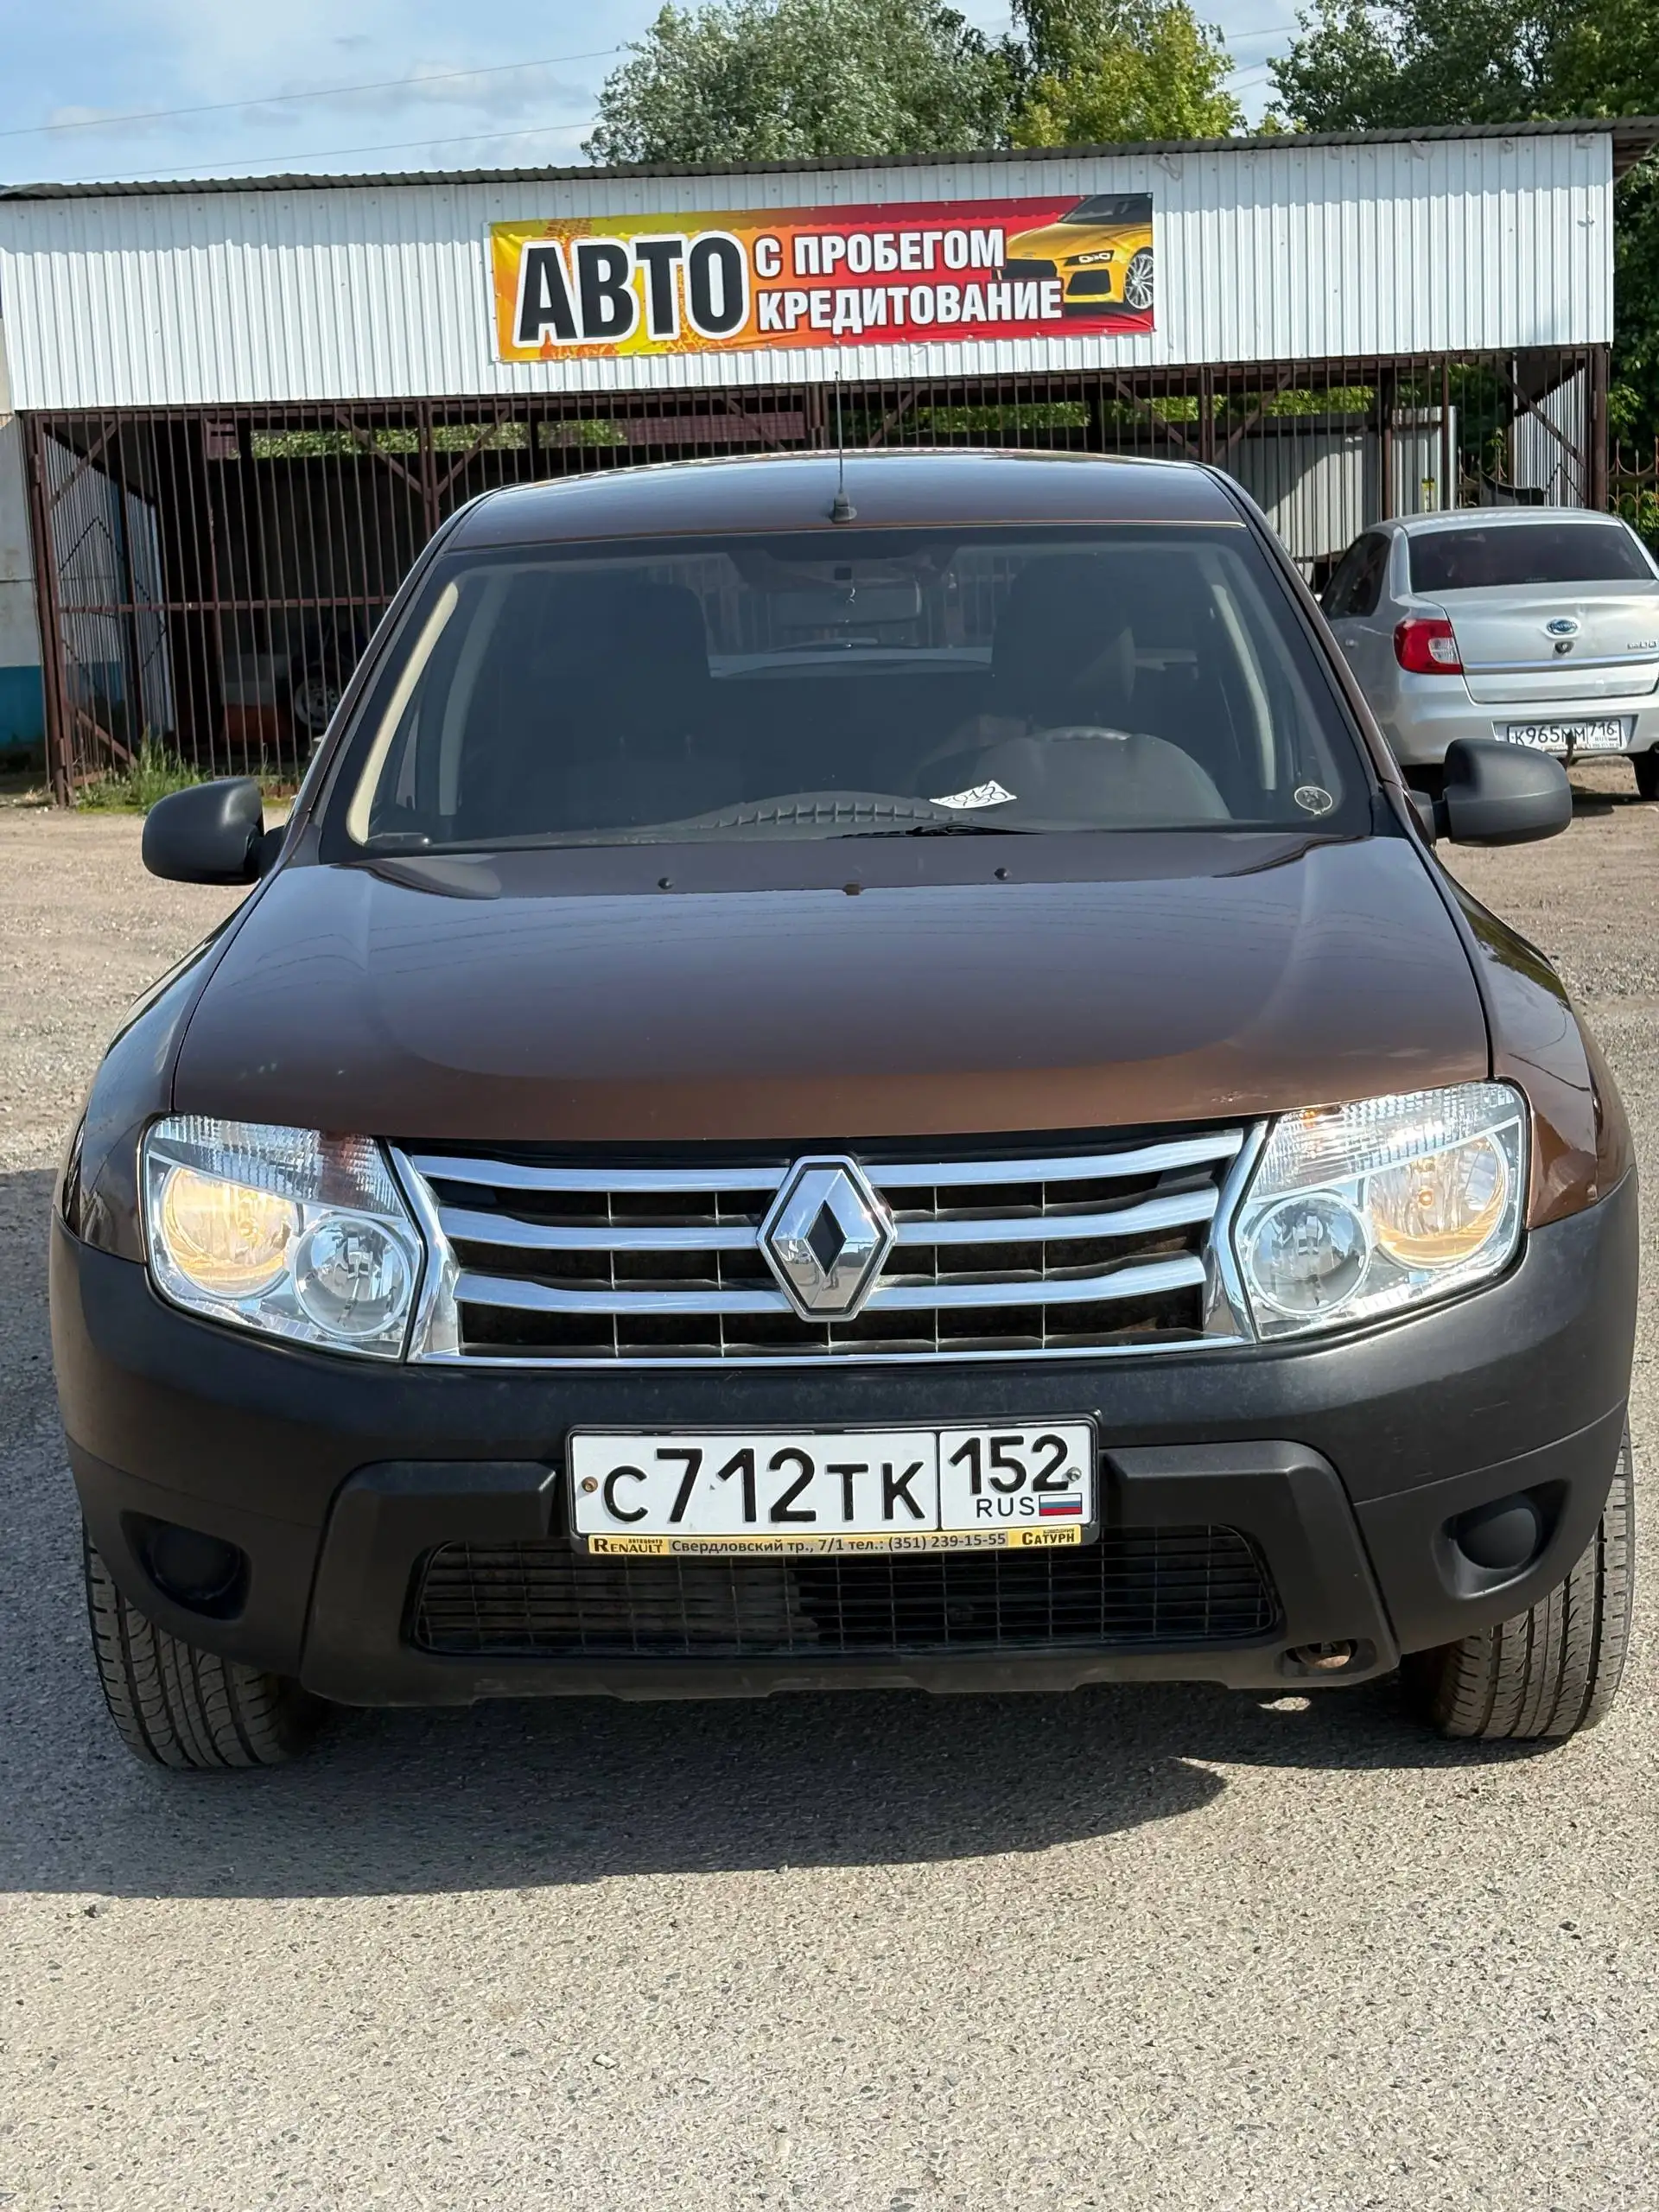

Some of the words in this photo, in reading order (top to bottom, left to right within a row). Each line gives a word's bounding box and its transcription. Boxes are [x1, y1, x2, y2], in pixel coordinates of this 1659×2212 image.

[755, 236, 781, 277] С
[795, 228, 1005, 275] ПРОБЕГОМ
[515, 232, 749, 344] АВТО
[757, 281, 1062, 334] КРЕДИТОВАНИЕ
[1588, 720, 1616, 735] 716
[604, 1447, 925, 1523] С712ТК
[949, 1433, 1069, 1495] 152
[976, 1497, 1034, 1518] RUS
[594, 1538, 664, 1554] RENAULT
[671, 1539, 783, 1553] Свердловский
[787, 1541, 814, 1554] тр.,
[818, 1538, 844, 1553] 7/1
[849, 1540, 884, 1550] тел.:
[888, 1535, 926, 1551] (351)
[931, 1533, 1007, 1548] 239-15-55
[1021, 1532, 1075, 1546] САТУРН
